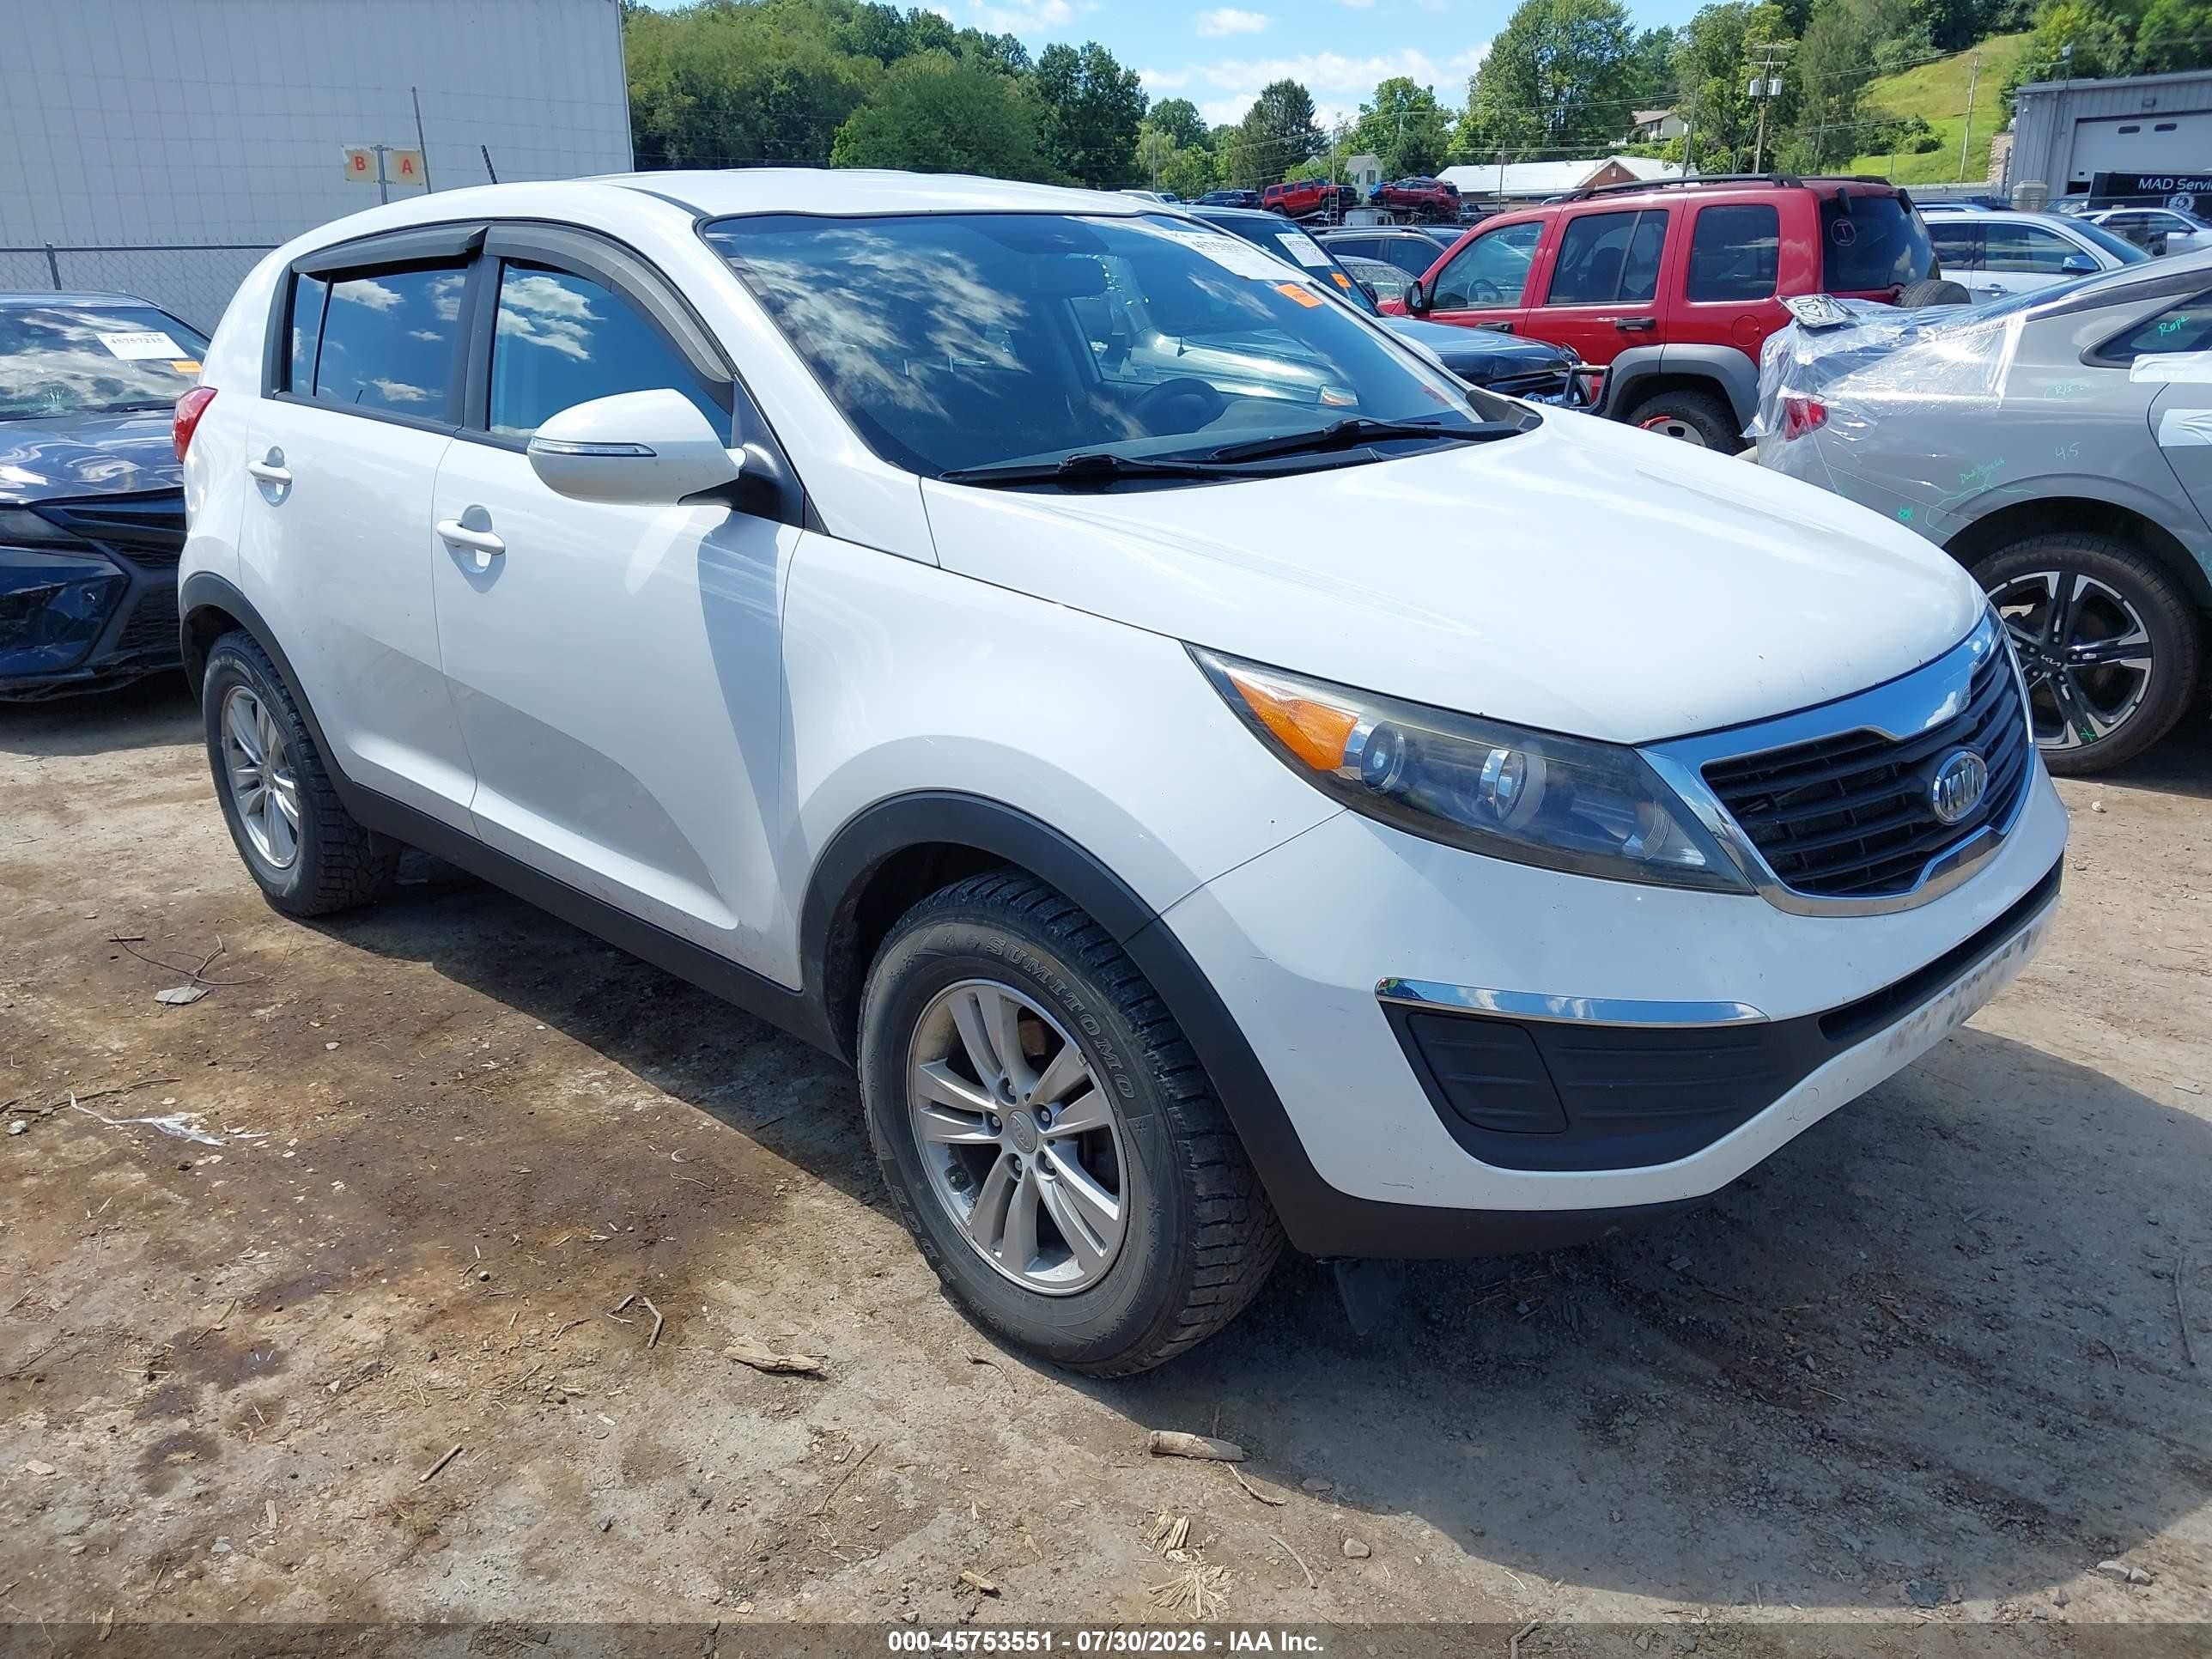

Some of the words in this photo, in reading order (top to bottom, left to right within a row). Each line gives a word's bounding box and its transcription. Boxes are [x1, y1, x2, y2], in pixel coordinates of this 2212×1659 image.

[355, 156, 366, 170] B
[402, 159, 413, 173] A
[2138, 178, 2173, 190] MAD
[1794, 297, 1823, 318] 230
[986, 935, 1135, 1099] SUMITOMO
